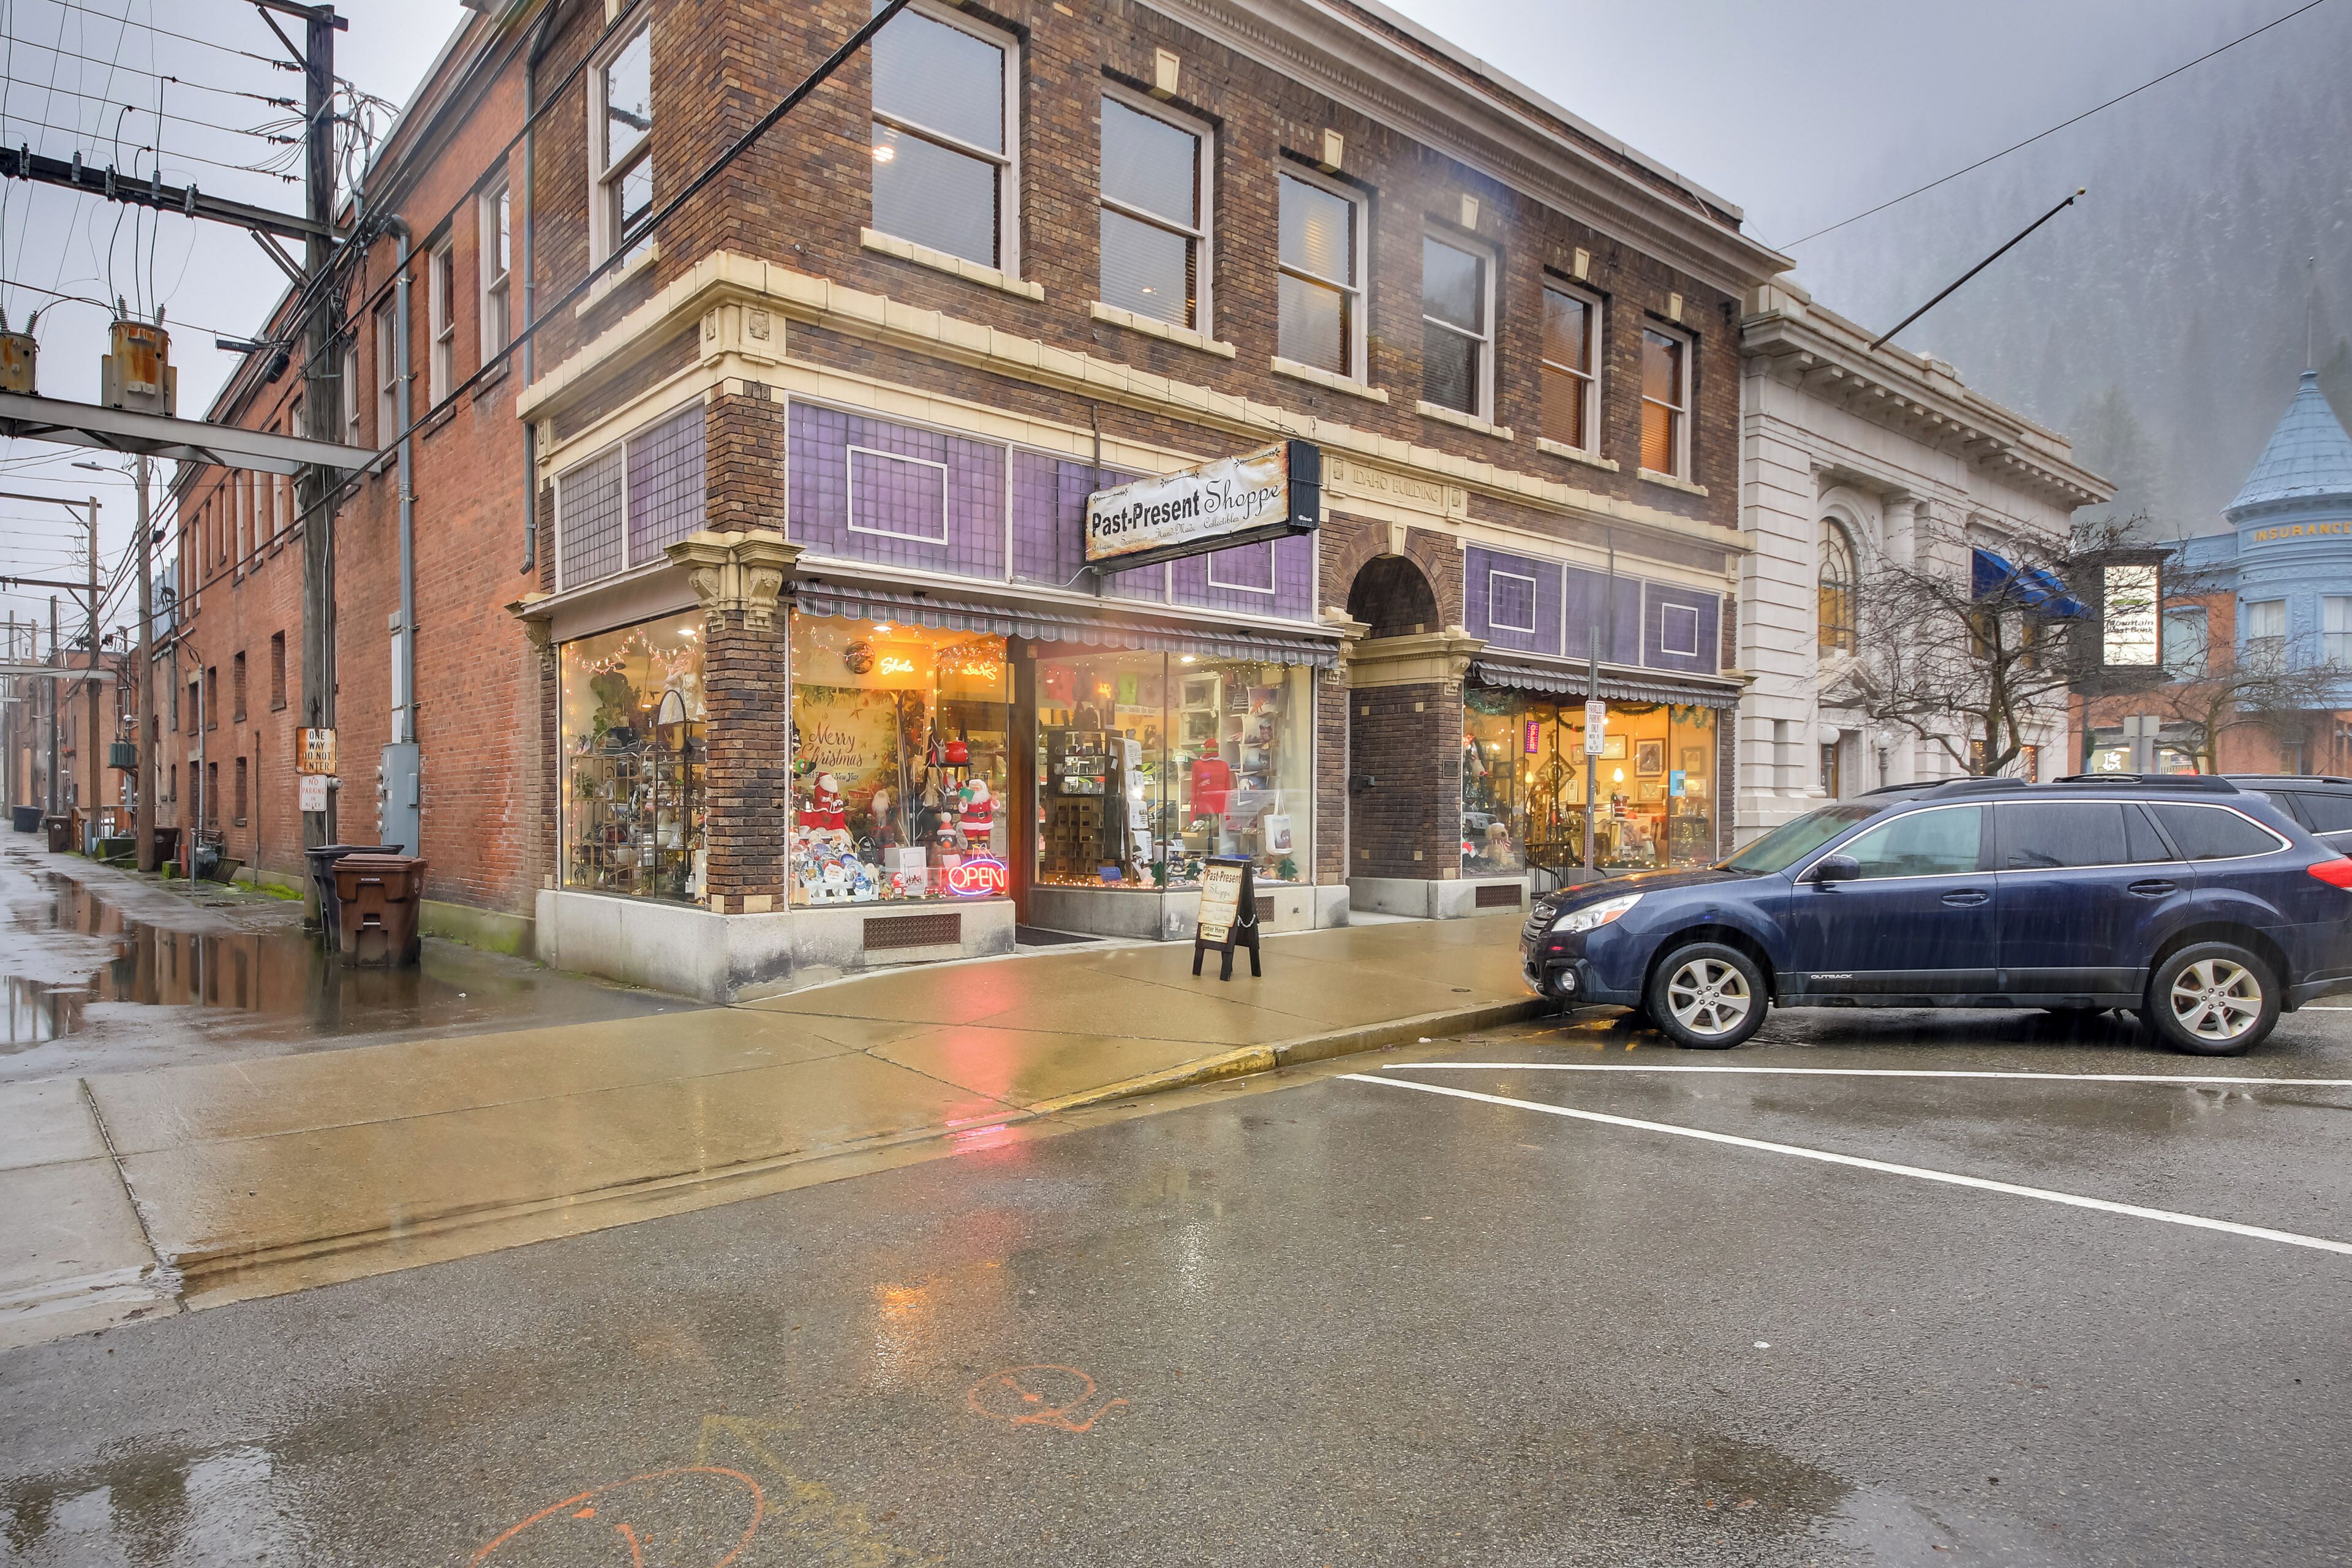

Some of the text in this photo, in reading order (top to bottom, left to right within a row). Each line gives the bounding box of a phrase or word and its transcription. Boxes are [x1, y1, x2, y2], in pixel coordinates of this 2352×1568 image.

[1353, 469, 1439, 502] IDAHO BUILDING
[1092, 479, 1281, 538] Past-Present Shoppe
[1091, 513, 1239, 552] Antiques Souvenirs Hand-Made Collectibles
[2255, 522, 2352, 541] INSURANCE
[309, 731, 325, 740] ONE
[809, 722, 855, 753] Merry
[309, 741, 325, 750] WAY
[316, 752, 331, 761] NOT
[802, 743, 863, 767] Christmas
[304, 761, 330, 771] ENTER
[846, 772, 859, 782] Year
[948, 866, 1005, 888] OPEN
[1206, 869, 1242, 884] Past-Present
[1208, 883, 1231, 900] Shoppe
